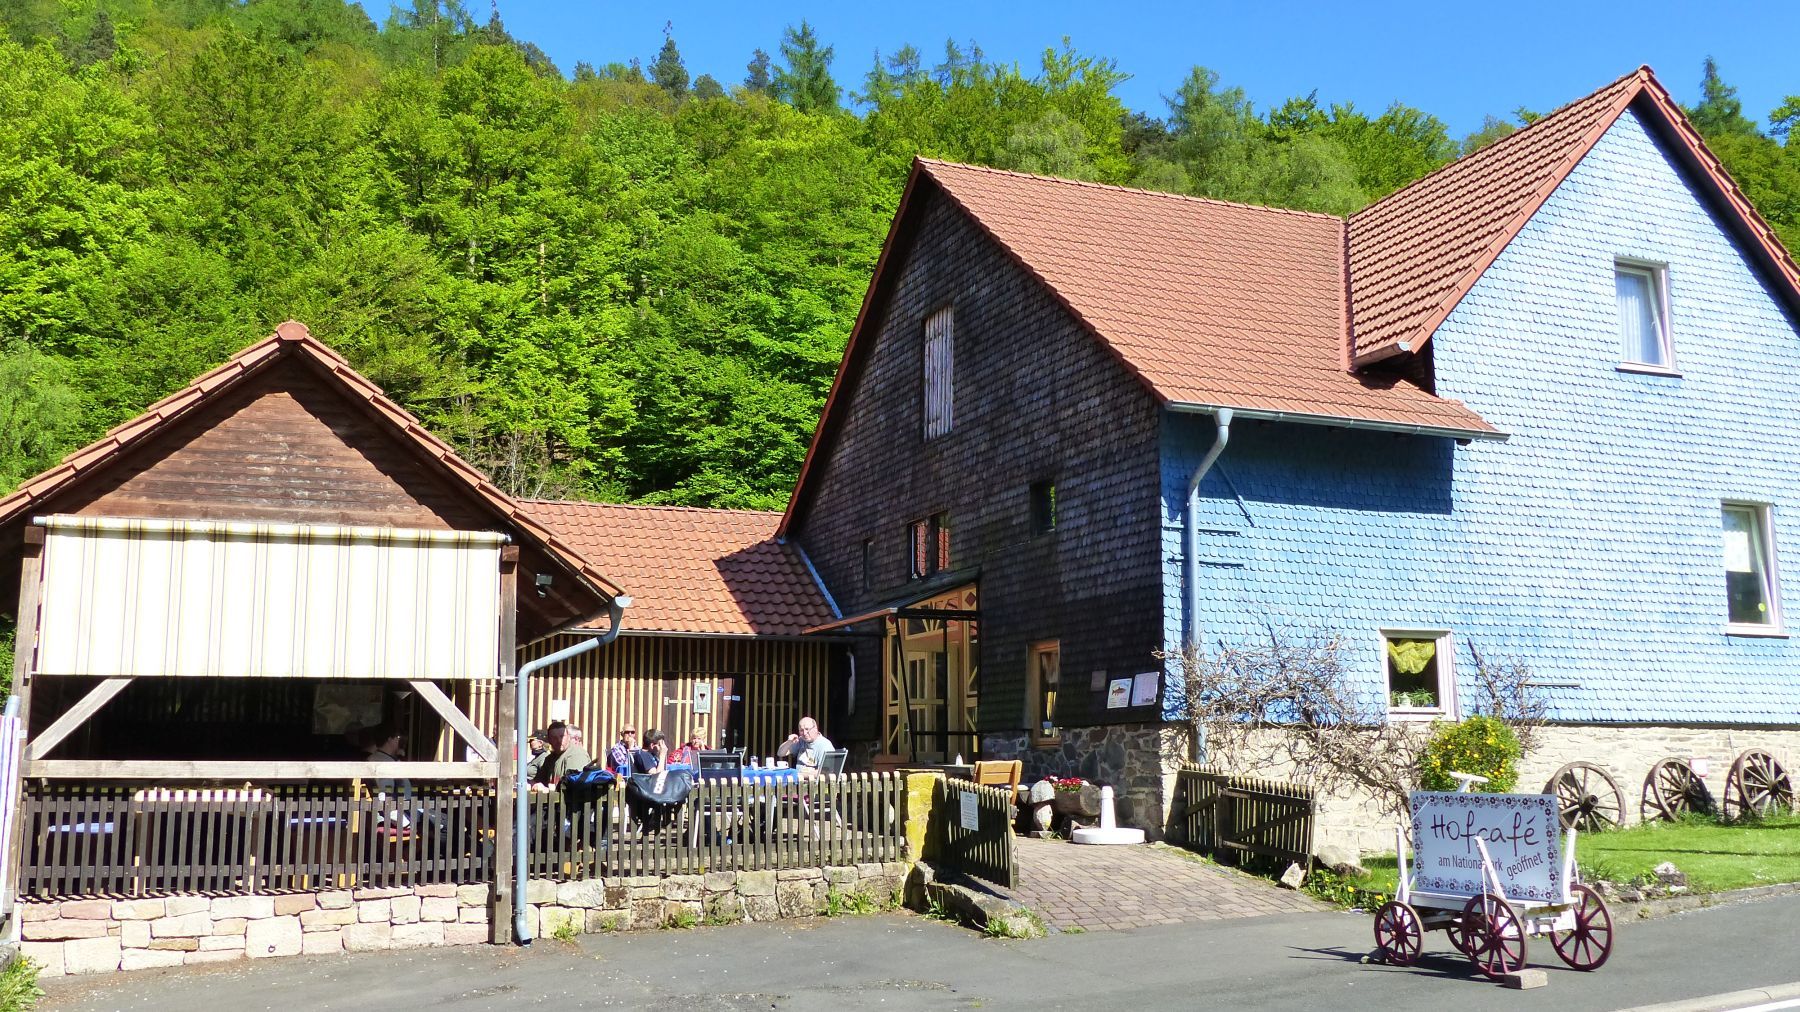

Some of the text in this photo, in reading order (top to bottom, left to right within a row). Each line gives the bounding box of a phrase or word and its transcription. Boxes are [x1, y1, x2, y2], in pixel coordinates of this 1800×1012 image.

[1438, 855, 1503, 871] am Nationark
[1507, 852, 1543, 880] geöffnet
